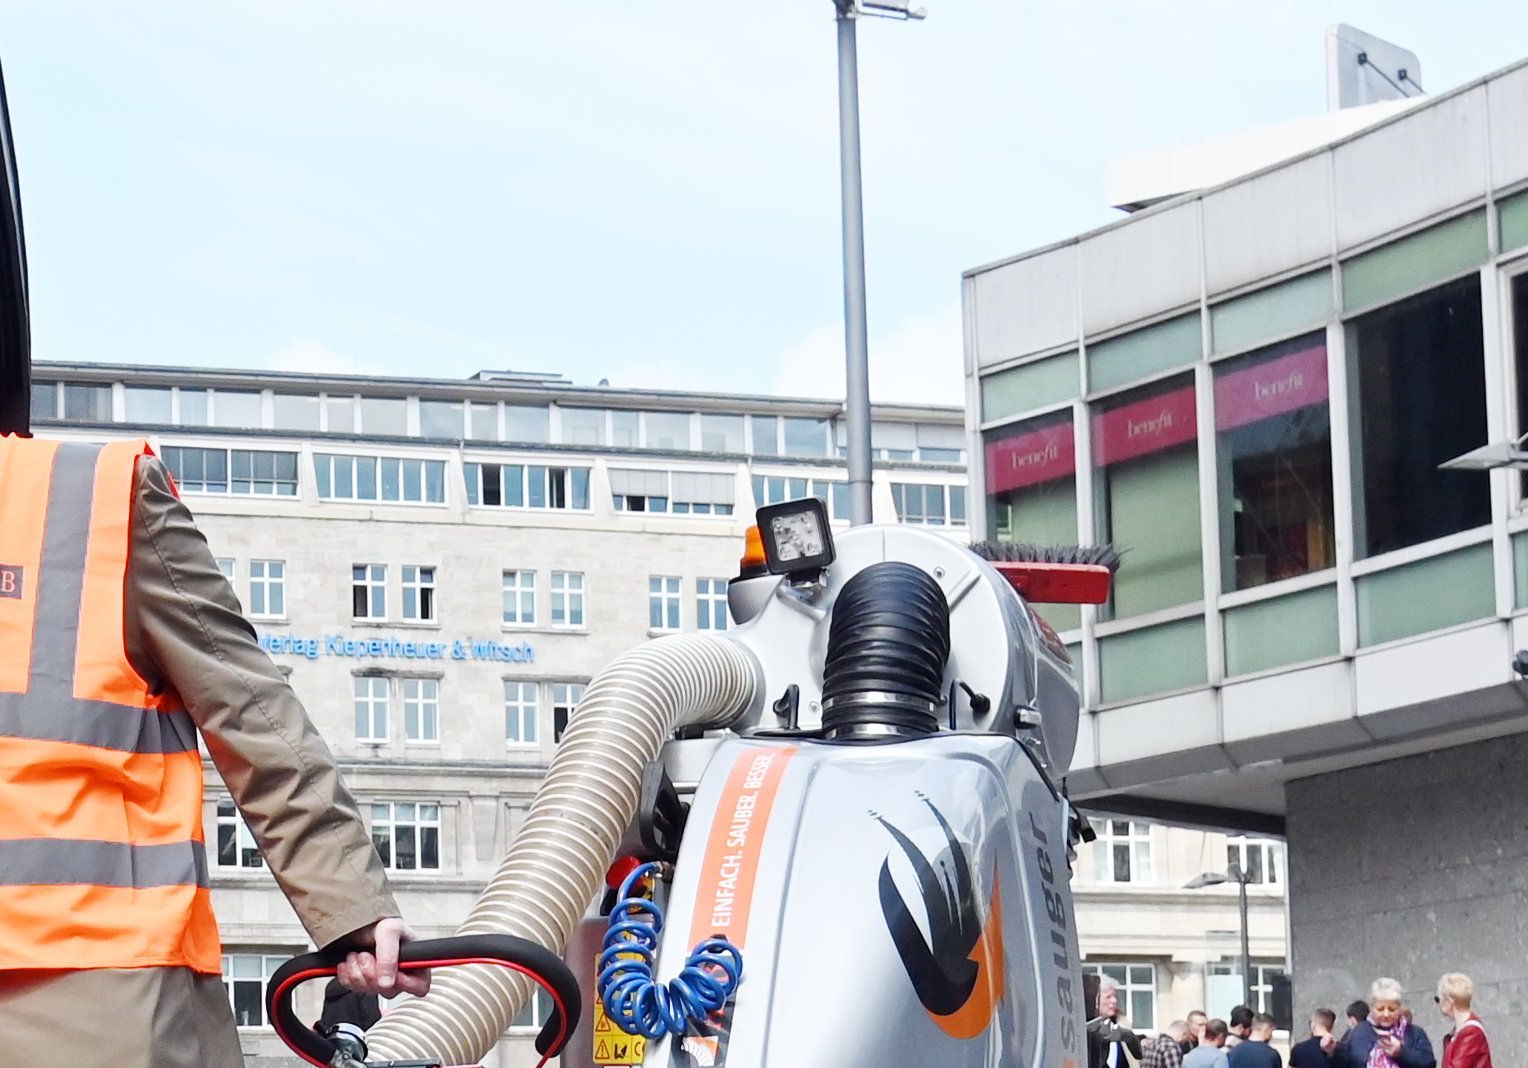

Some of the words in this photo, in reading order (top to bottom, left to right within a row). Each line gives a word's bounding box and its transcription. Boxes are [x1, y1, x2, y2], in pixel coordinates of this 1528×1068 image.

[1253, 371, 1304, 400] benefit
[1127, 409, 1172, 438] benefit
[1011, 442, 1059, 471] benefit
[259, 632, 320, 660] Verlag
[325, 634, 446, 660] Kiepenheuer
[451, 639, 466, 661] &
[471, 638, 537, 664] Witsch
[727, 791, 760, 848] SAUBER.
[711, 850, 744, 928] EINFACH.
